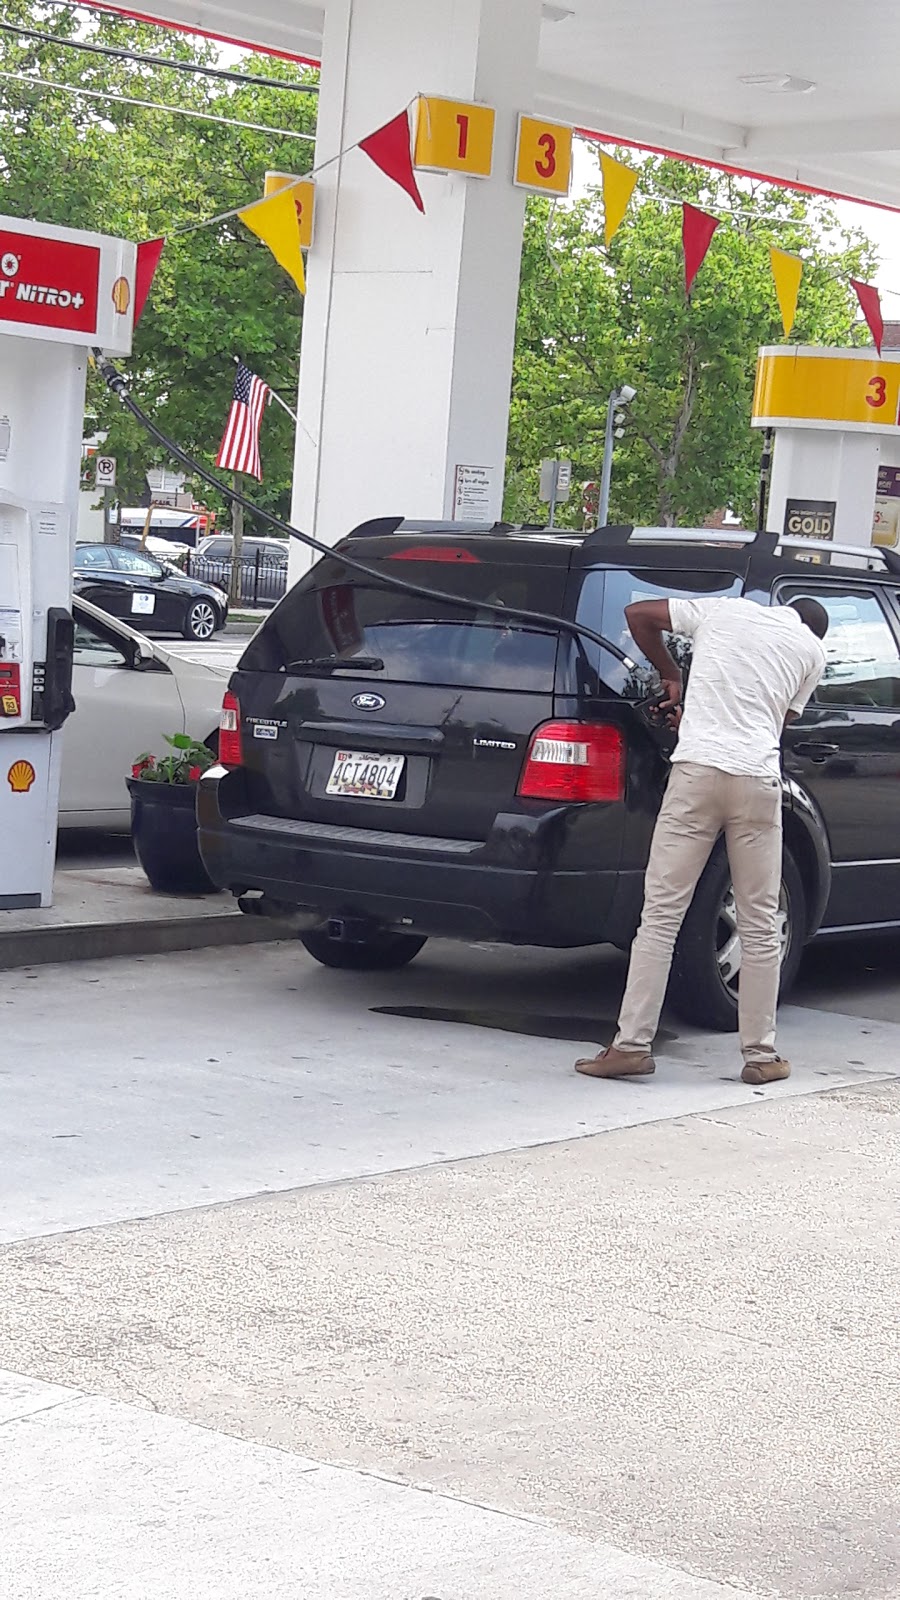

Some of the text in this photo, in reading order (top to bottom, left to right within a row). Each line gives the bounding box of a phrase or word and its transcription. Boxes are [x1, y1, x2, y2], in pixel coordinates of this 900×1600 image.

[456, 114, 469, 159] 1
[535, 133, 556, 178] 3
[865, 376, 886, 408] 3
[788, 516, 831, 534] GOLD
[245, 716, 288, 728] FREESTYLE
[473, 738, 516, 750] LIMITED
